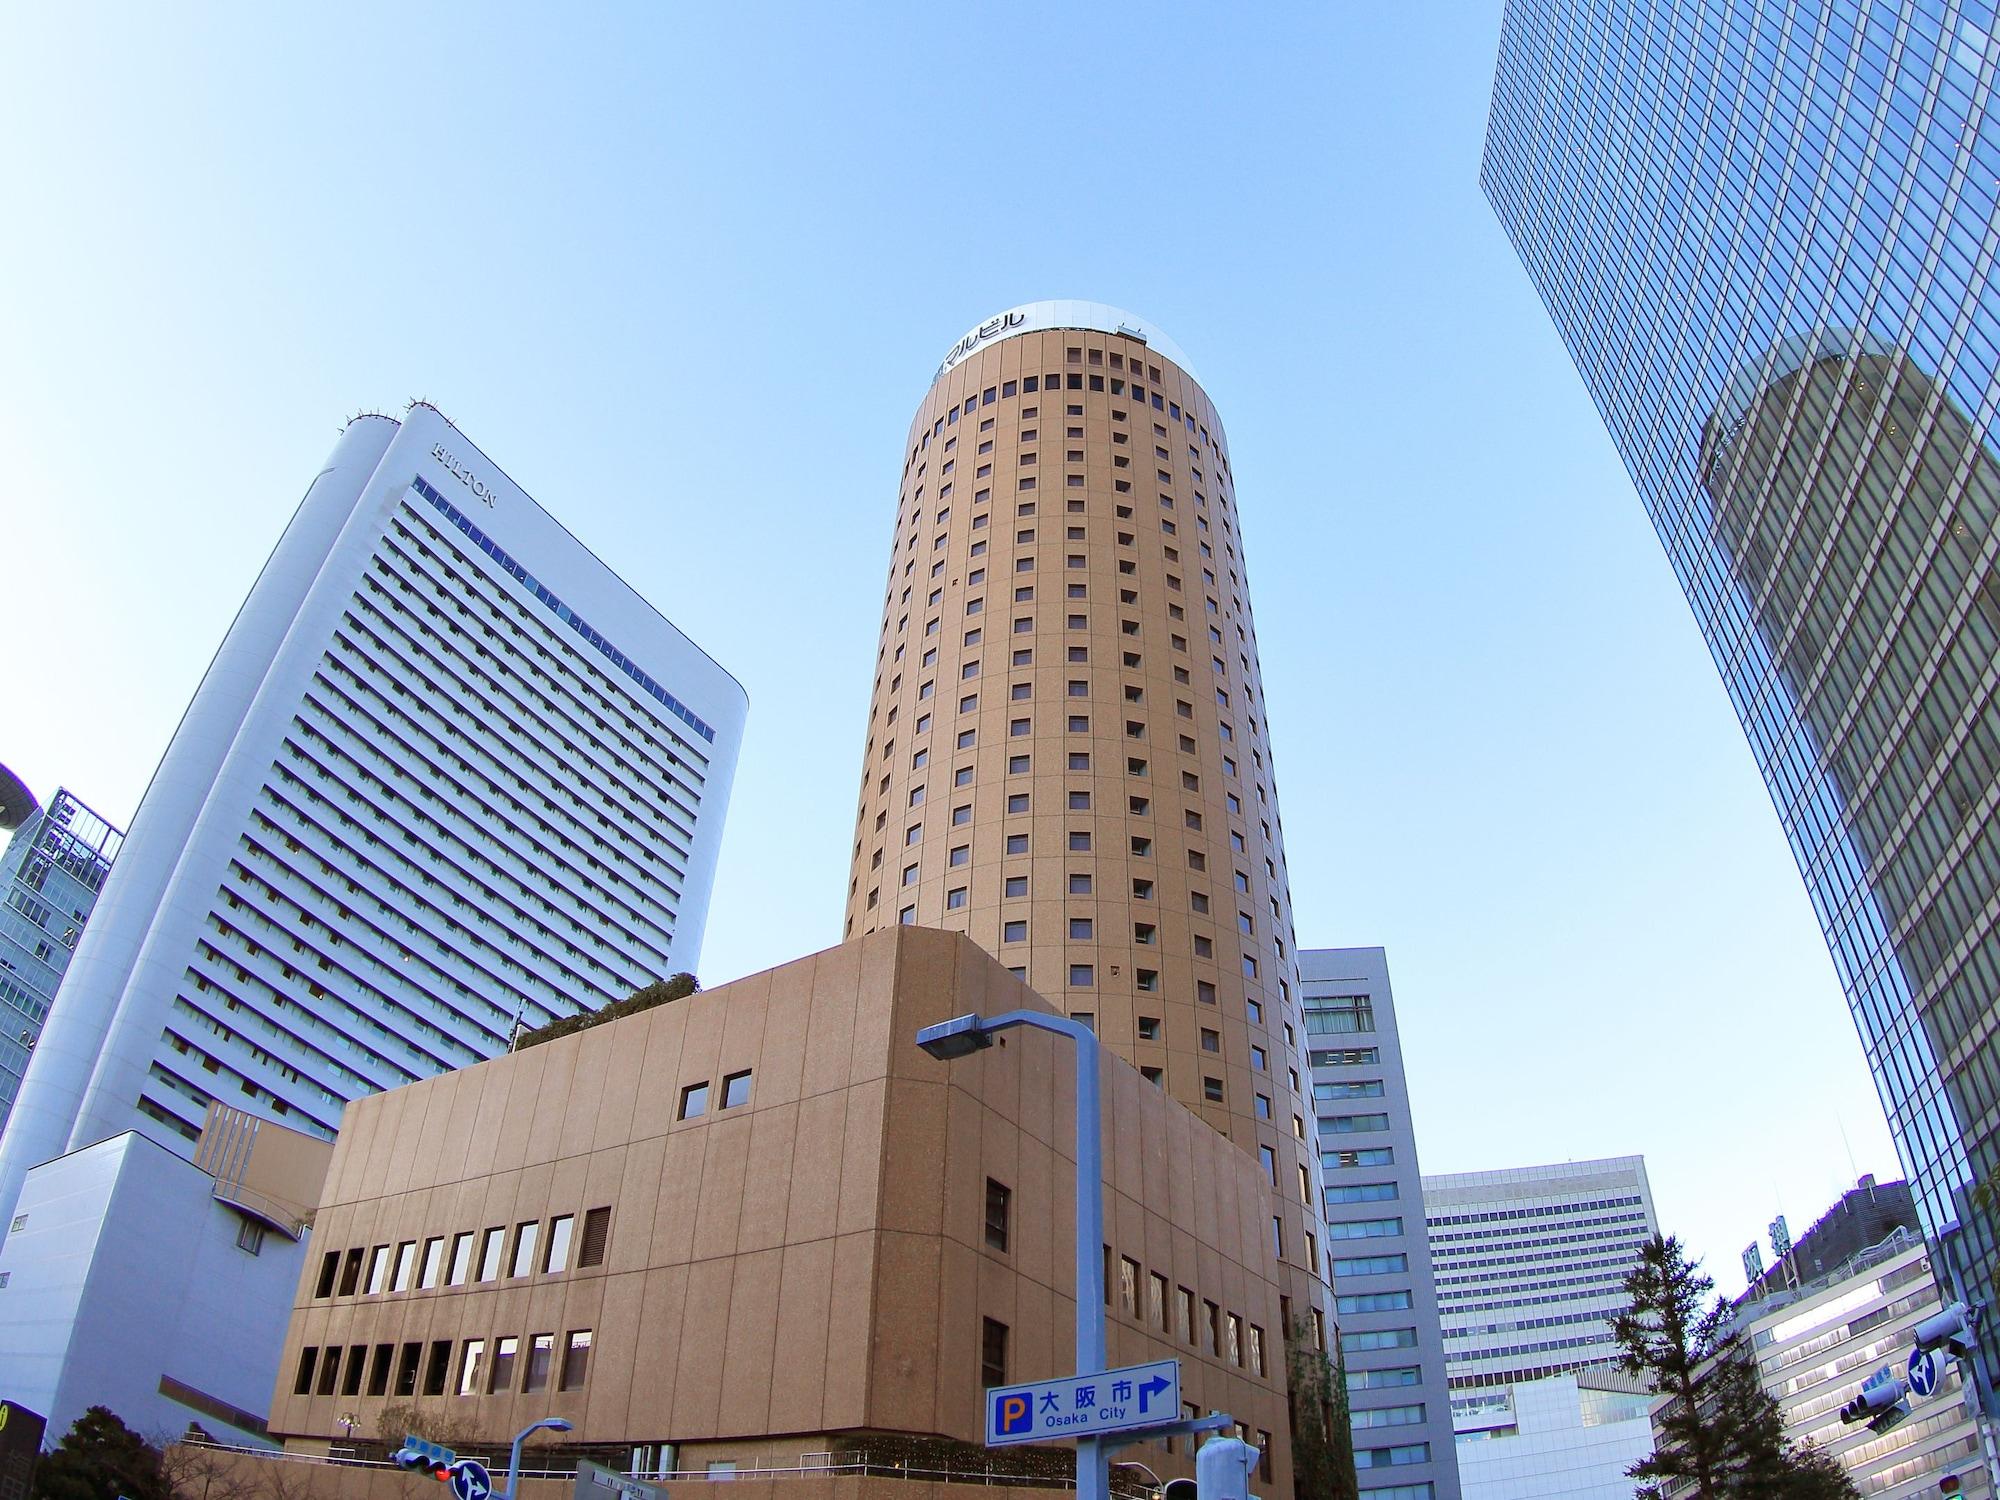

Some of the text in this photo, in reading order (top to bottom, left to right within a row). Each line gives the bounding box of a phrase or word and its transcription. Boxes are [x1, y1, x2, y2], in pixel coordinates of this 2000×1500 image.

[431, 442, 497, 508] HILTON
[1003, 1379, 1132, 1432] P 大阪市
[1046, 1406, 1126, 1428] Osaka City
